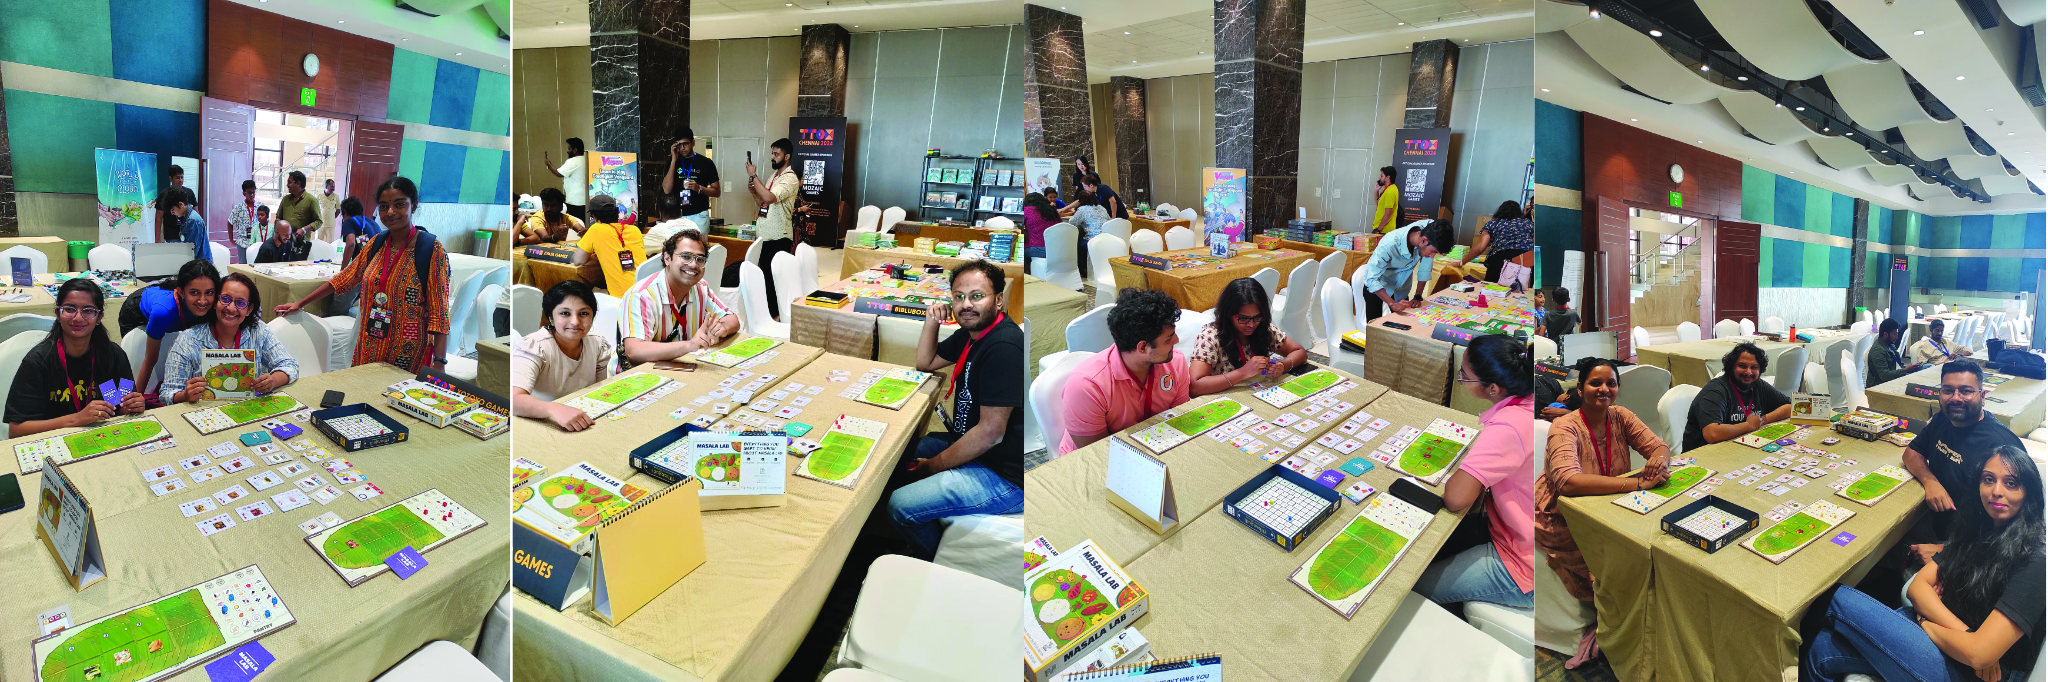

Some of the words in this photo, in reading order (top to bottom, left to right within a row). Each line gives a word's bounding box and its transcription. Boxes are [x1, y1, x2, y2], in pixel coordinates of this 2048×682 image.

[895, 307, 926, 315] BIBLUBOX
[1446, 329, 1473, 340] TTOX
[398, 401, 418, 414] MASALA
[418, 410, 429, 418] LAB
[486, 402, 510, 418] GAMES
[579, 464, 606, 481] MASALA
[604, 478, 620, 487] LAB
[1039, 537, 1052, 552] MASALA
[514, 550, 553, 578] GAMES
[1082, 551, 1109, 580] MASALA
[1104, 577, 1120, 590] LAB
[253, 622, 273, 634] PANTRY
[1064, 629, 1106, 662] MASALA
[1109, 613, 1127, 630] LAB
[239, 652, 258, 672] MASALA
[239, 659, 250, 670] LAB
